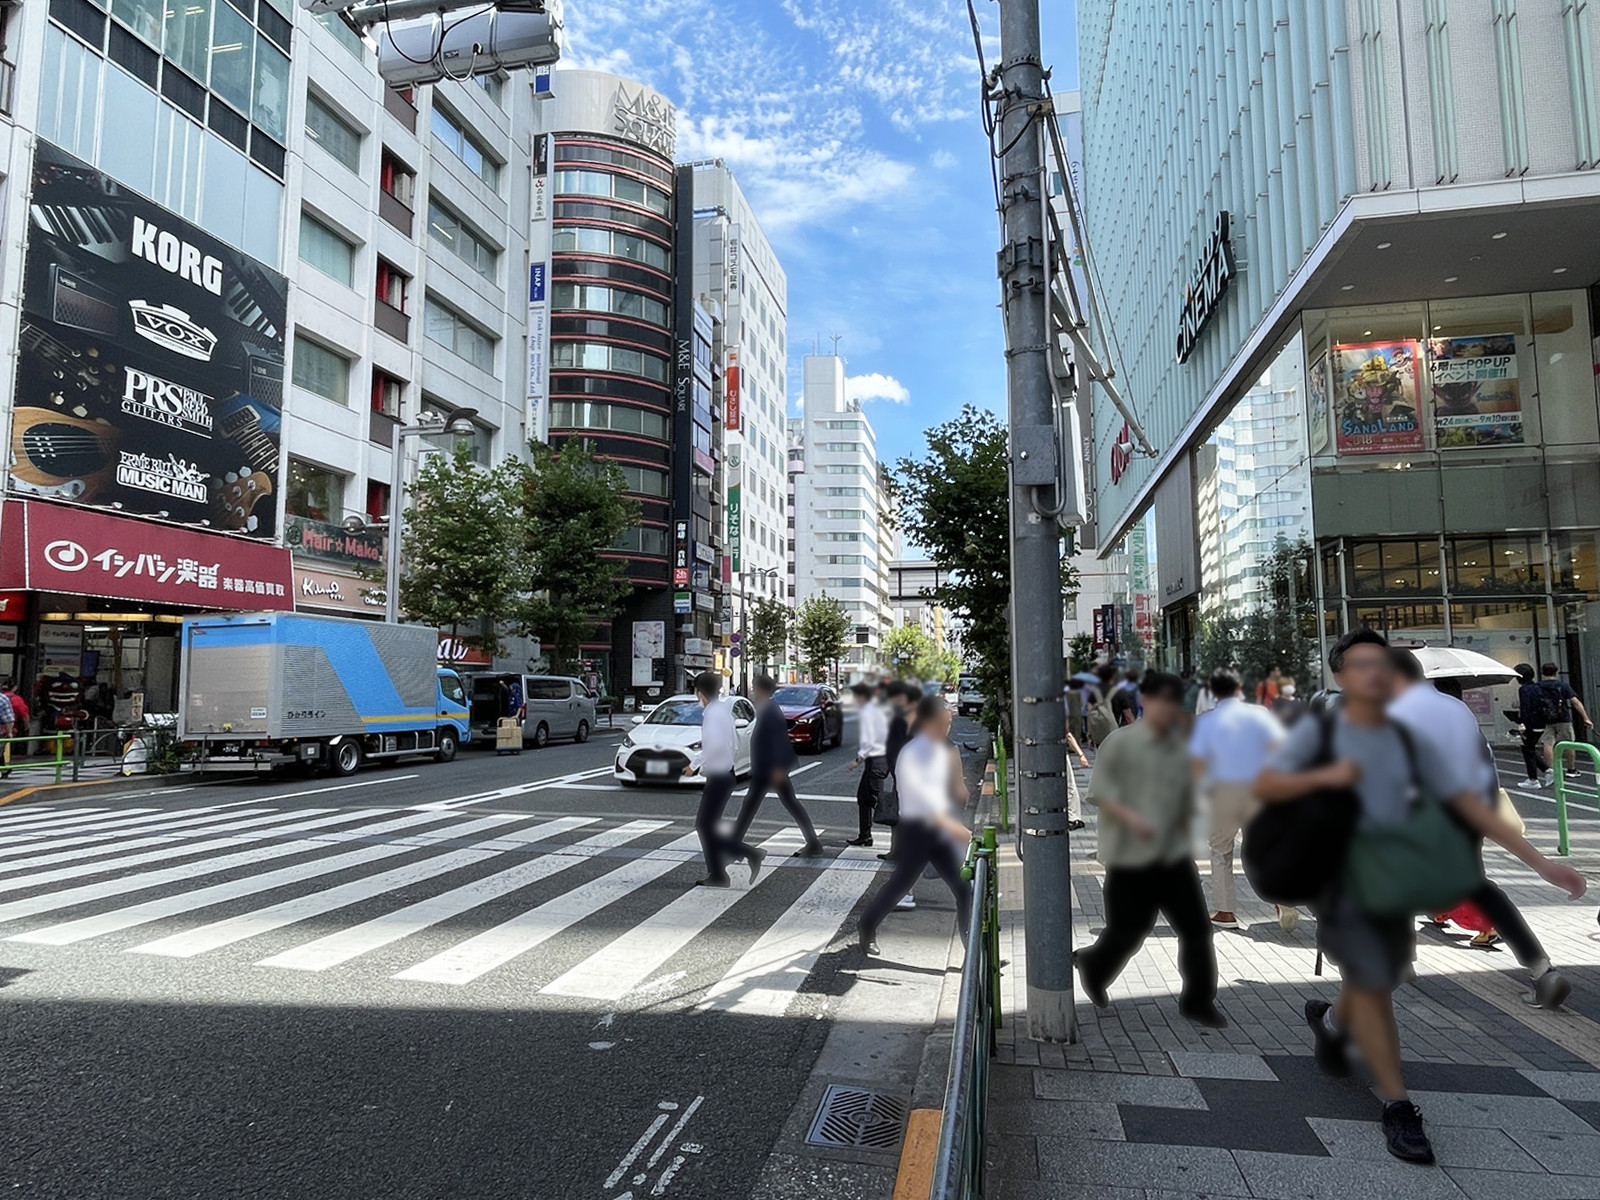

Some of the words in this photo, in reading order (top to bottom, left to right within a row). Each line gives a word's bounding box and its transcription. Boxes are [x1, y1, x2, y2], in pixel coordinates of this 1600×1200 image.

[131, 215, 223, 297] KORG
[1175, 239, 1231, 365] CINEMA
[141, 312, 206, 350] VOX
[677, 340, 692, 370] M&E
[122, 368, 183, 416] PRS
[121, 400, 184, 428] GUITARS
[181, 408, 214, 428] SMITH
[1082, 436, 1091, 462] ANNEX
[120, 467, 171, 492] MUSIC
[172, 480, 204, 500] MAN
[92, 548, 221, 590] イシバシ楽器
[222, 576, 286, 598] 楽器高価買取
